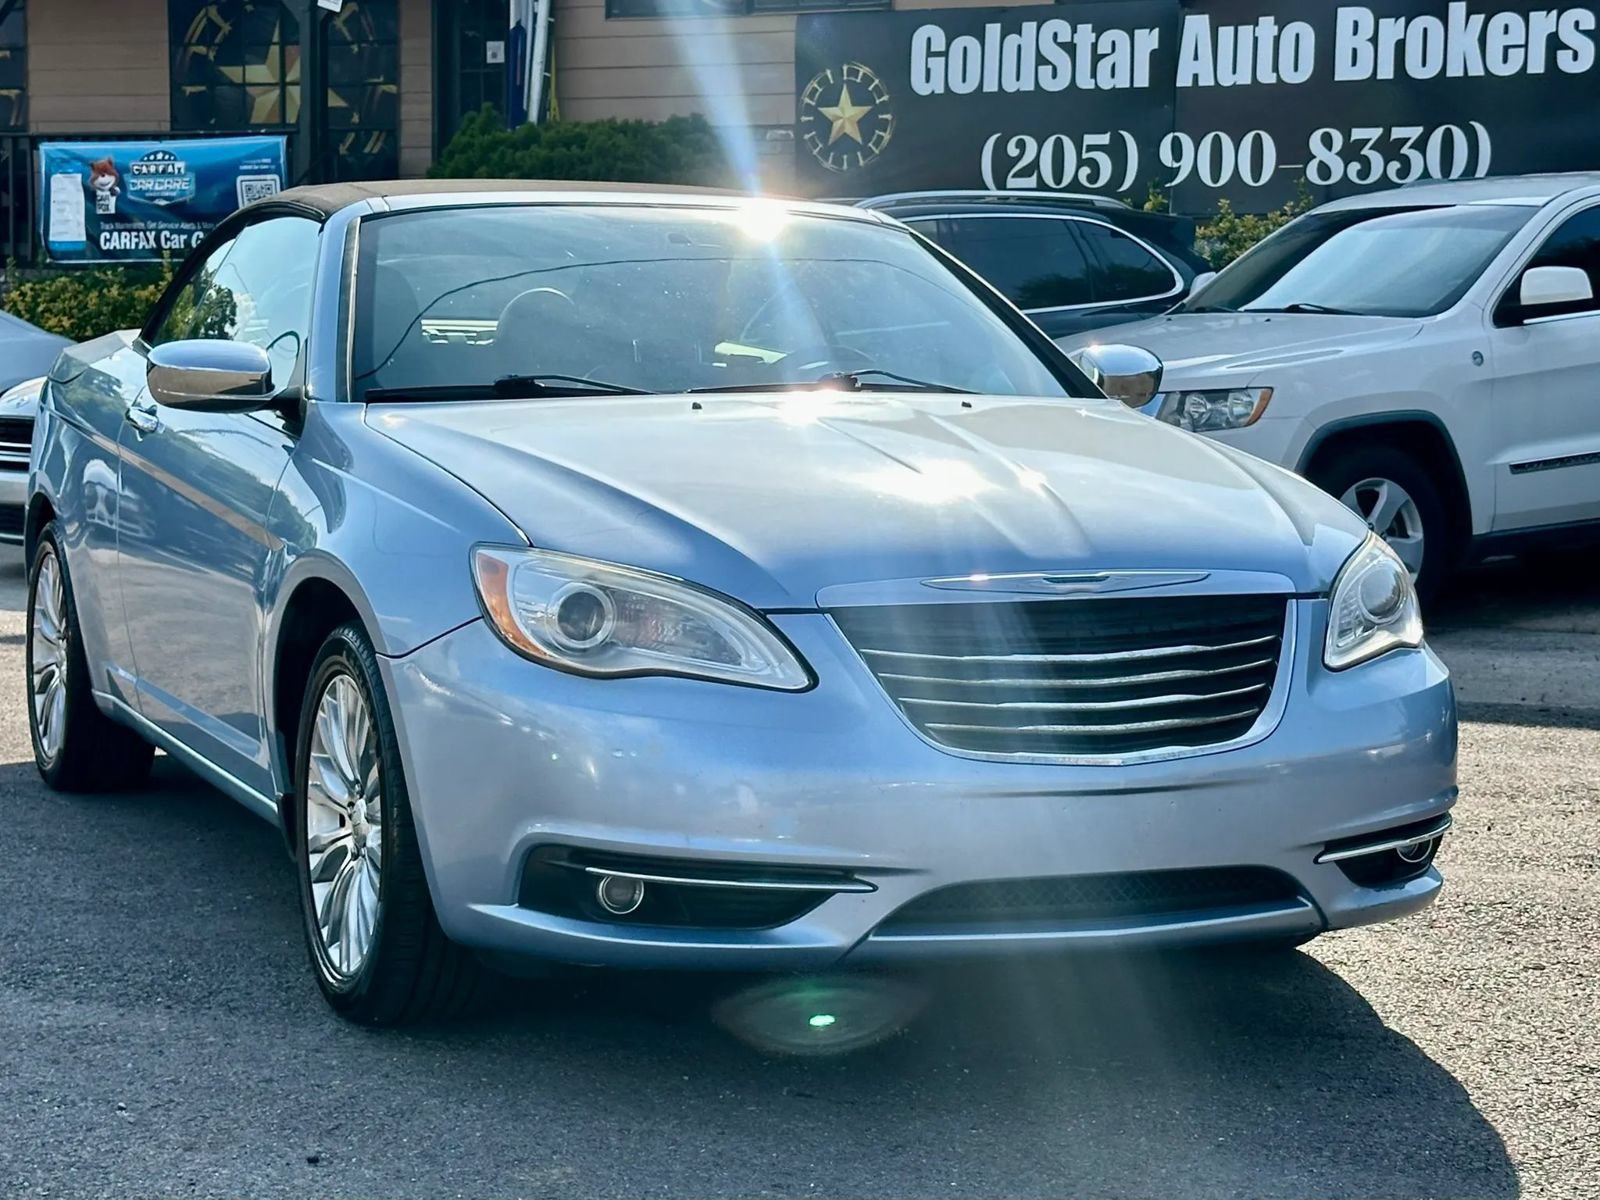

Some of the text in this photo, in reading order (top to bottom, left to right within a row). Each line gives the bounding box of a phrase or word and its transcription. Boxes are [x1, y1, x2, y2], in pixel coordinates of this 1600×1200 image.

[910, 2, 1596, 96] GoldStar Auto Brokers
[132, 163, 185, 175] CARFAX
[981, 121, 1492, 192] (205) 900-8330)
[99, 231, 157, 250] CARFAX
[160, 230, 188, 249] Car
